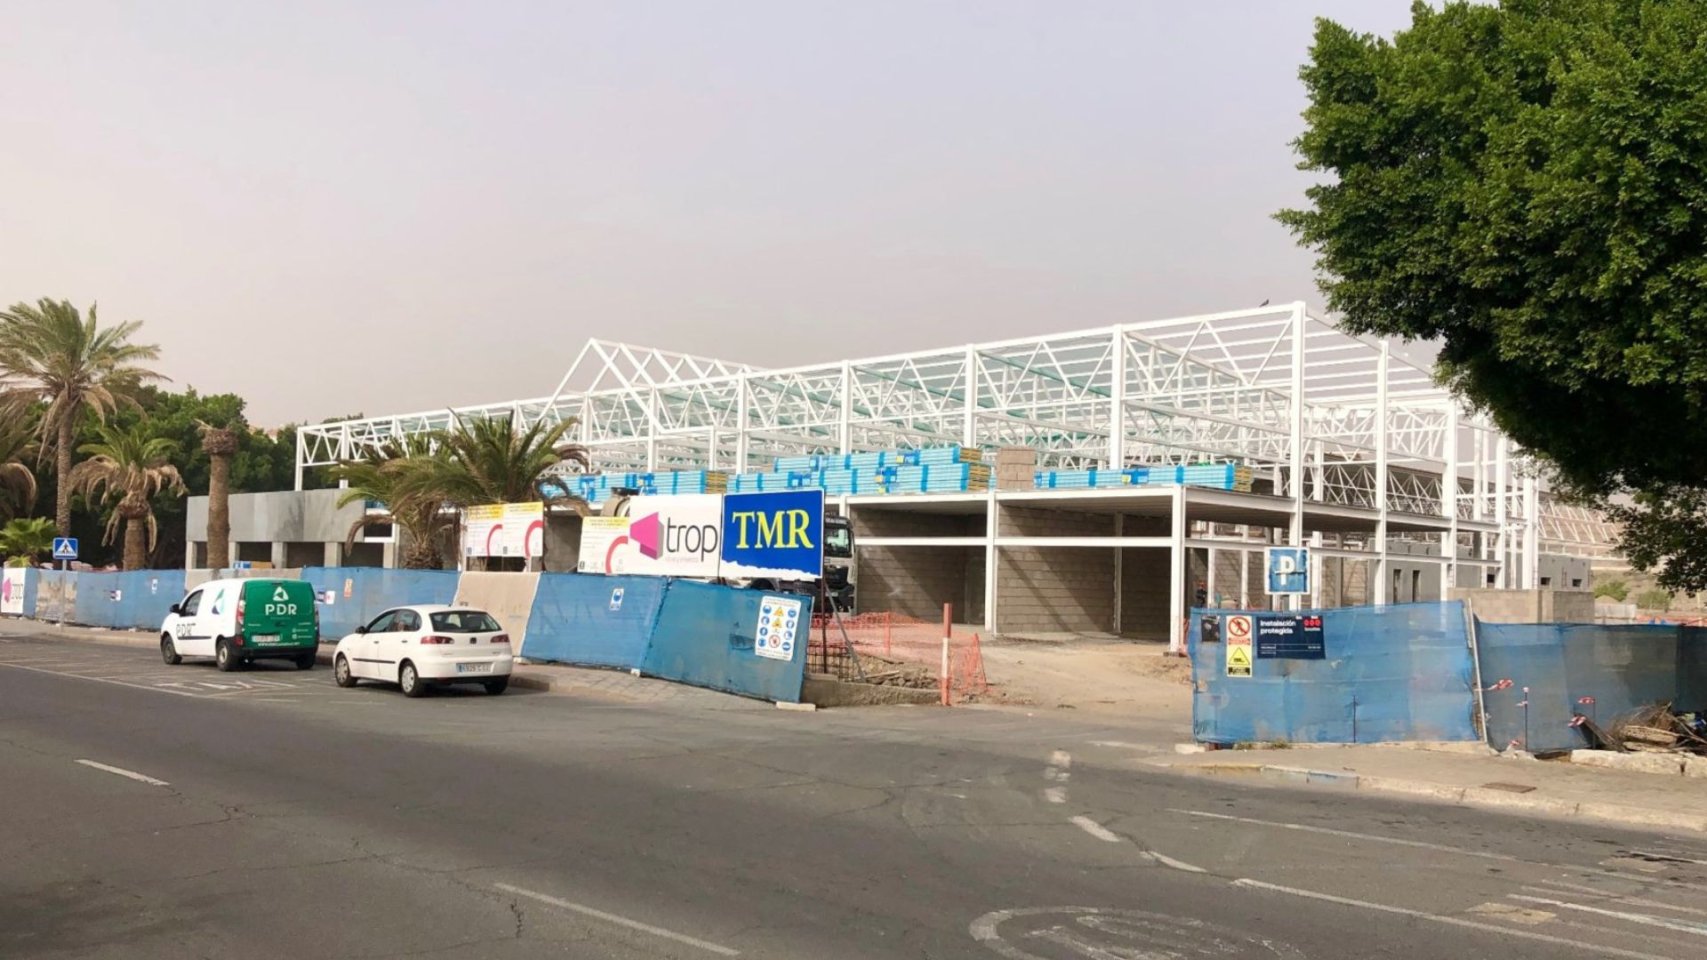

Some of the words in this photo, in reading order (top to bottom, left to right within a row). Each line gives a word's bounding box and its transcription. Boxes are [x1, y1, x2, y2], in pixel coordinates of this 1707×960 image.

[666, 517, 718, 562] trop
[731, 509, 814, 549] TMR
[1280, 555, 1295, 585] P
[265, 603, 297, 616] PDR
[1260, 619, 1296, 627] Instalación
